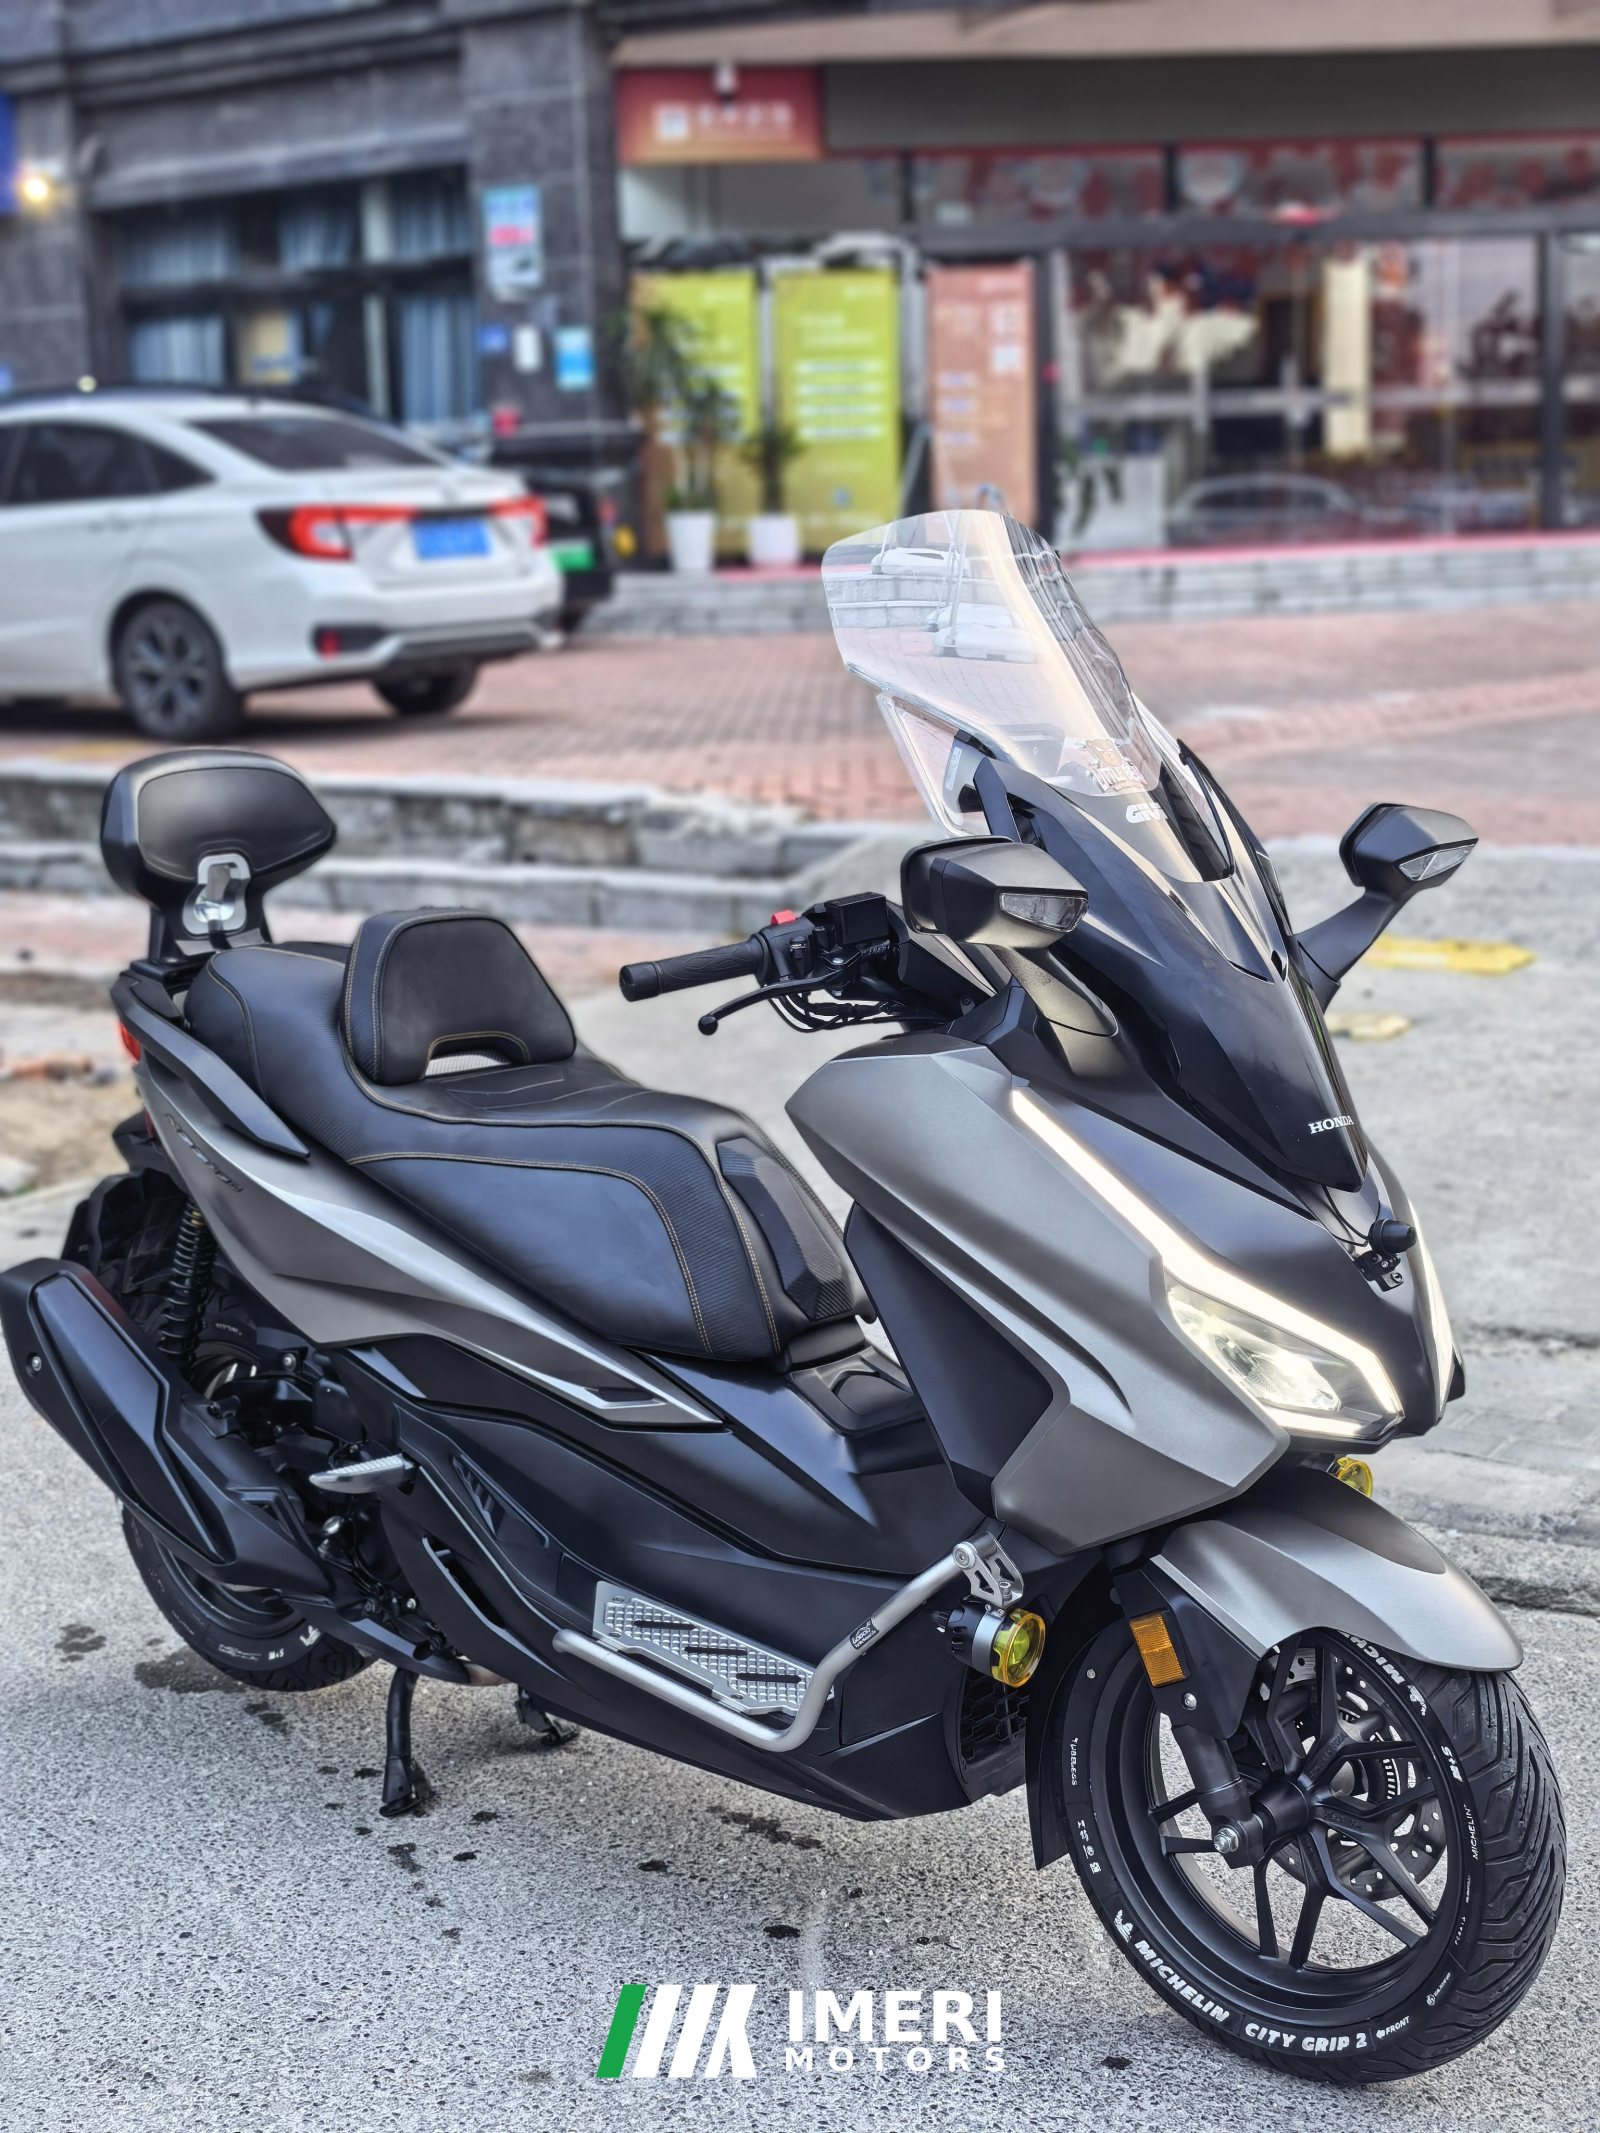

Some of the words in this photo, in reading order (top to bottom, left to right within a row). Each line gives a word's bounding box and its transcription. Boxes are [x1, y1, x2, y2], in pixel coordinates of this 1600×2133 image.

[1308, 1115, 1355, 1135] HONDA
[1464, 1808, 1478, 1860] MICHELIN
[1134, 1939, 1230, 2022] MICHELIN
[1245, 2022, 1296, 2049] CITY
[1301, 2035, 1350, 2052] GRIP
[1356, 2032, 1367, 2049] 2
[1385, 2015, 1410, 2035] FRONT
